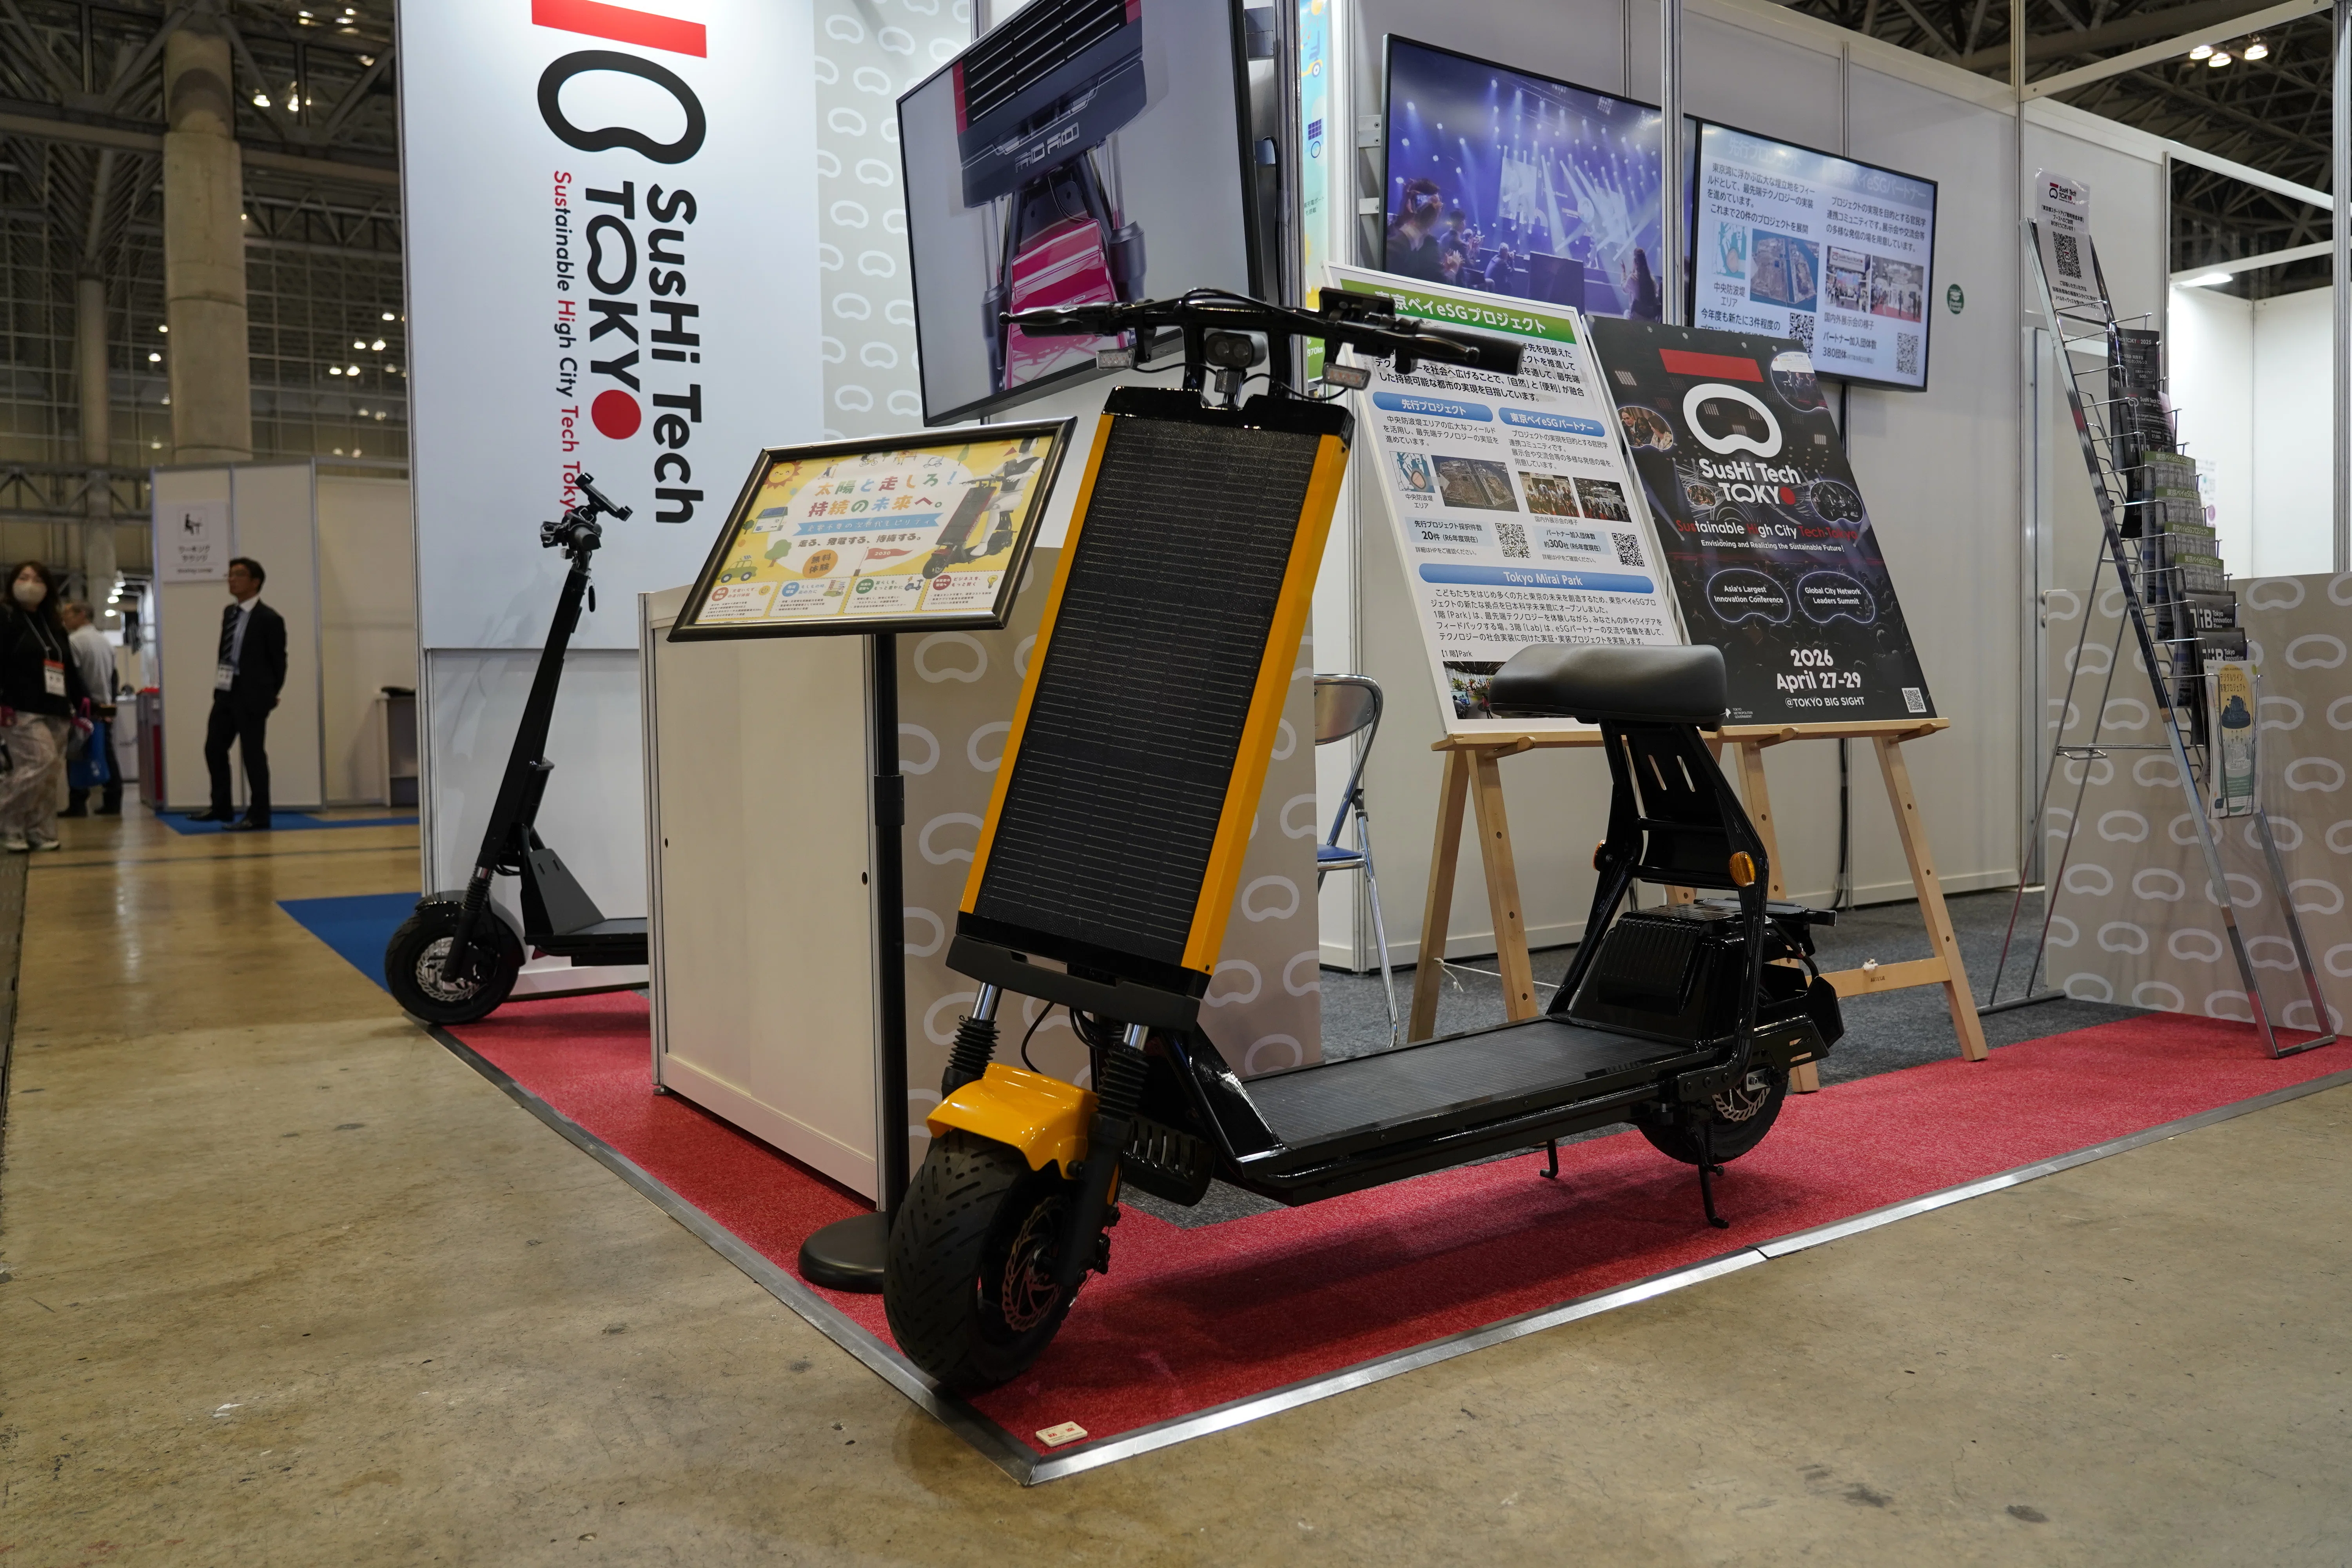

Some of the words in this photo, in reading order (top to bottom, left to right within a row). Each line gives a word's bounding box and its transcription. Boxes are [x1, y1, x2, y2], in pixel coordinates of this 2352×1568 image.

[1708, 175, 1814, 209] ルドとして、最先端テクノロジーの実装
[1708, 189, 1754, 209] を進めています。
[2059, 186, 2069, 194] SusHi
[1710, 203, 1809, 234] これまで20件のプロジェクトを展開
[1831, 196, 1926, 227] プロジェクトの実現を目的とする官民学
[554, 171, 575, 291] Sustainable
[647, 183, 700, 363] SusHi
[1714, 281, 1745, 297] 中央防波堤
[1720, 296, 1738, 307] エリア
[554, 300, 576, 348] High
[1701, 308, 1780, 331] 今年度も新たに3件程度の
[1824, 312, 1874, 330] 国内外展示会の様子
[1823, 331, 1877, 350] パートナー加入団体数
[1822, 347, 1847, 359] 380団体
[556, 357, 577, 397] City
[1379, 372, 1540, 402] した持続可能な都市の実現を目指しています。
[1401, 399, 1466, 416] 先行プロジェクト
[561, 405, 579, 452] Tech
[1387, 416, 1496, 434] 中央防波堤エリアの広大なフィールド
[1510, 412, 1594, 431] 東京ベイeSGパートナー
[1383, 425, 1499, 444] を活用し、最先端テクノロジーの実証を
[1385, 436, 1430, 446] 進めています。
[1511, 430, 1608, 449] プロジェクトの実現を目的とする官民学
[653, 384, 704, 523] Tech
[1508, 438, 1566, 452] 連携コミュニティです。
[1511, 448, 1614, 468] 展示会や交流会等の多様な発信の場を、
[1514, 458, 1557, 470] 用意しています。
[1699, 458, 1755, 481] SusHi
[1756, 463, 1801, 484] Tech
[807, 495, 942, 517] 持続の未来へ。
[1405, 494, 1434, 502] 中央防波堤
[1414, 520, 1483, 532] 先行プロジェクト採択件数
[1534, 516, 1578, 526] 国内外展示会の様子
[1421, 531, 1440, 541] 20件
[1546, 530, 1596, 540] パートナー加入団体数
[1676, 520, 1745, 534] Sustainable
[1746, 523, 1773, 538] High
[1775, 524, 1797, 539] City
[1798, 526, 1825, 537] Tech
[1826, 528, 1858, 541] Tokyo
[797, 533, 921, 548] 走る、発電する、持続する。
[1543, 539, 1569, 549] 約300社
[1700, 539, 1737, 548] Envisioning
[1750, 542, 1777, 550] Realizing
[1789, 543, 1822, 551] Sustainable
[1823, 544, 1845, 552] Future!
[1415, 546, 1477, 556] 詳細はHPをご確認ください。
[1542, 554, 1596, 563] 詳細はHPをご確認ください。
[1503, 572, 1534, 585] Tokyo
[1535, 573, 1560, 584] Mirai
[1562, 575, 1583, 586] Park
[1431, 599, 1608, 614] ジェクトの新たな拠点を日本科学未来館にオープンしました。
[1435, 589, 1657, 606] こどもたちをはじめ多くの方と東京の未来を創造するため、東京ベイeSGプロ
[1439, 633, 1645, 645] テクノロジーの社会実装に向けた実証・実装プロジェクトを実施します。
[1790, 649, 1834, 667] 2026
[1777, 670, 1817, 693] April
[1819, 671, 1861, 689] 27-29
[1785, 697, 1823, 708] @TOKYO
[1824, 697, 1839, 706] BIG
[1840, 697, 1865, 706] SIGHT
